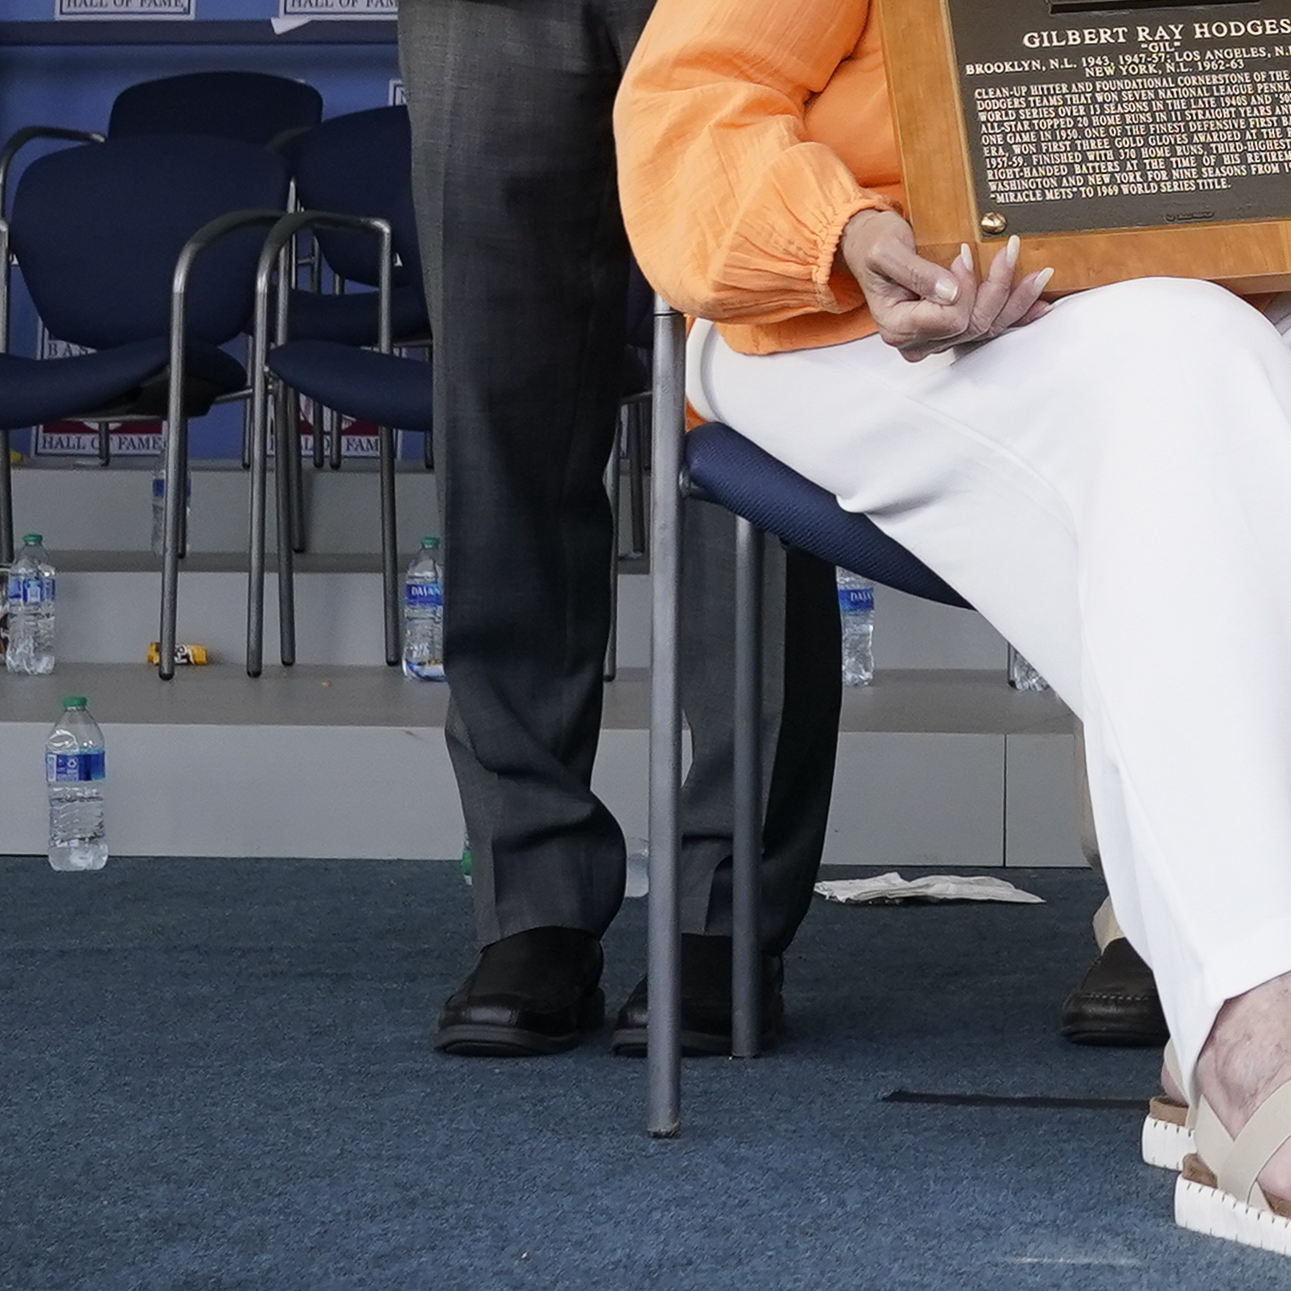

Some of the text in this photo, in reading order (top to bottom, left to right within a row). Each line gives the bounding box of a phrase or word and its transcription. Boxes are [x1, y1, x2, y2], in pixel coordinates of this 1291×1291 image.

[1022, 19, 1291, 47] GILBERT RAY HODGES
[41, 435, 86, 451] HALL
